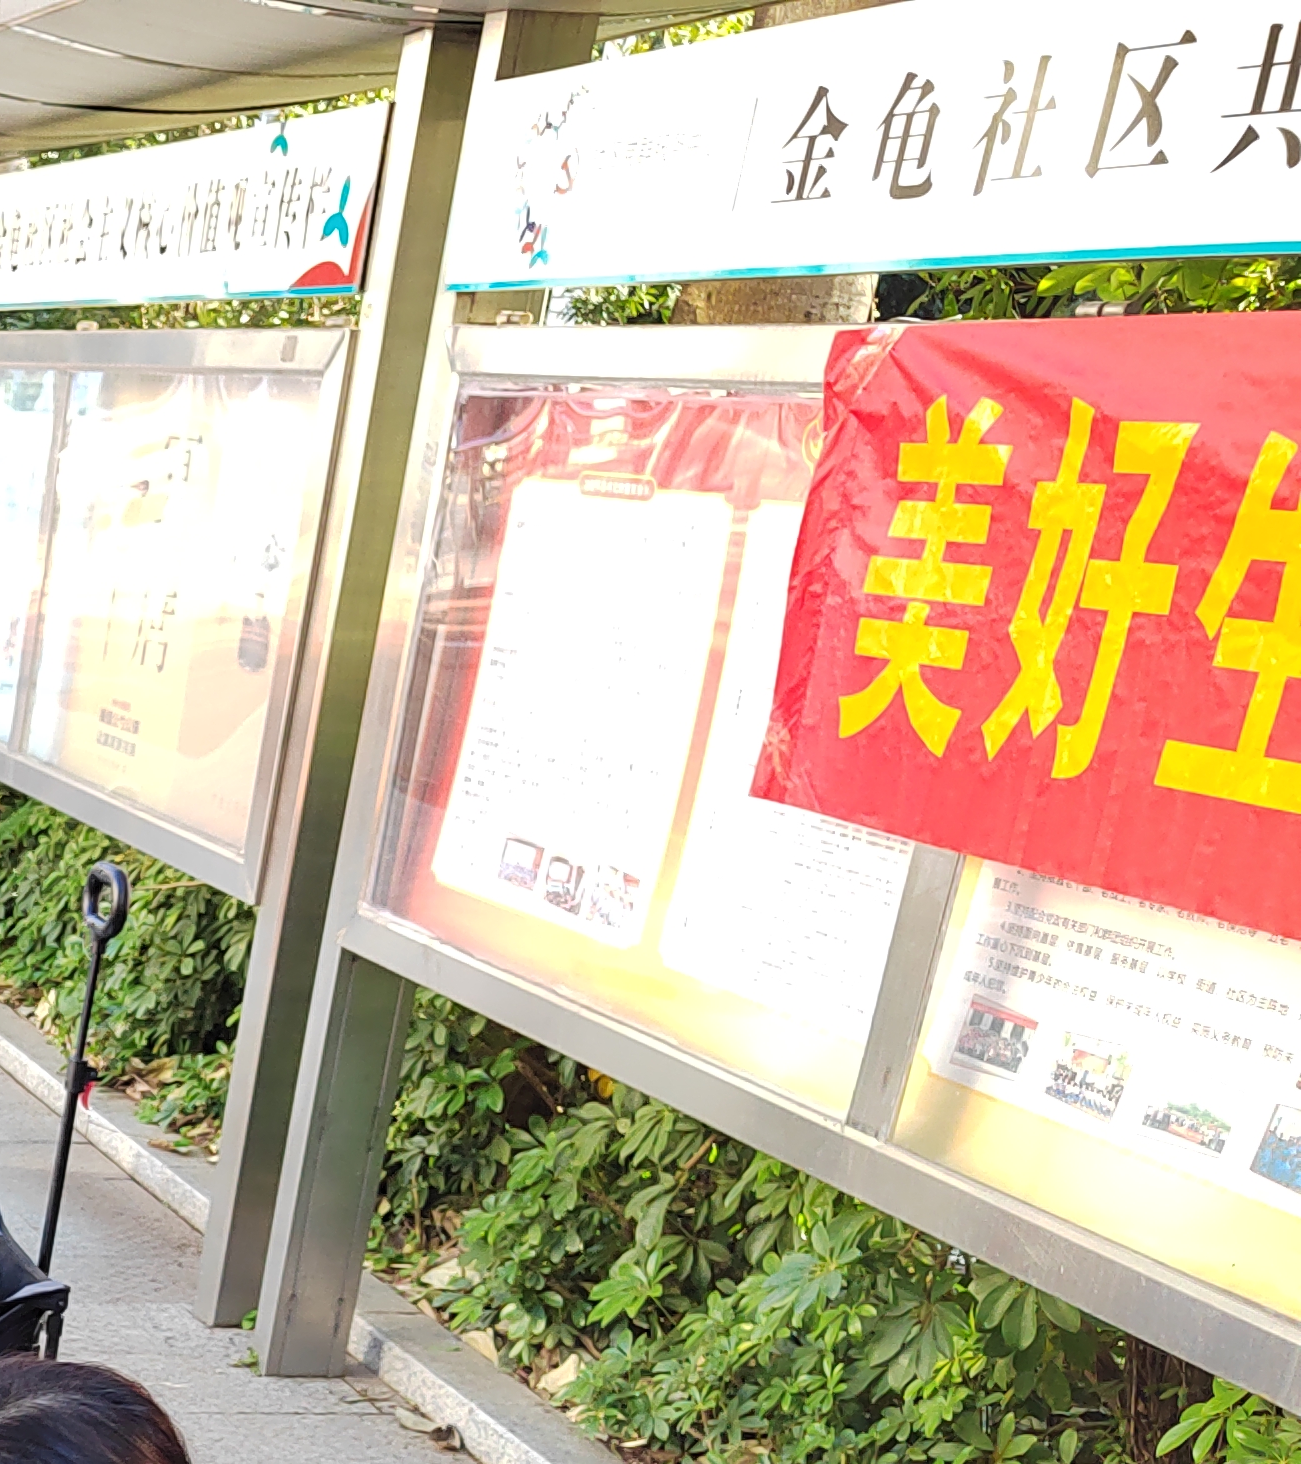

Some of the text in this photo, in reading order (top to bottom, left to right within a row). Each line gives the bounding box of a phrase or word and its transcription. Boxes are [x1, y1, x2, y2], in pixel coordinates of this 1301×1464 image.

[771, 22, 1301, 206] 金龟社区共
[837, 392, 1301, 814] 美好生
